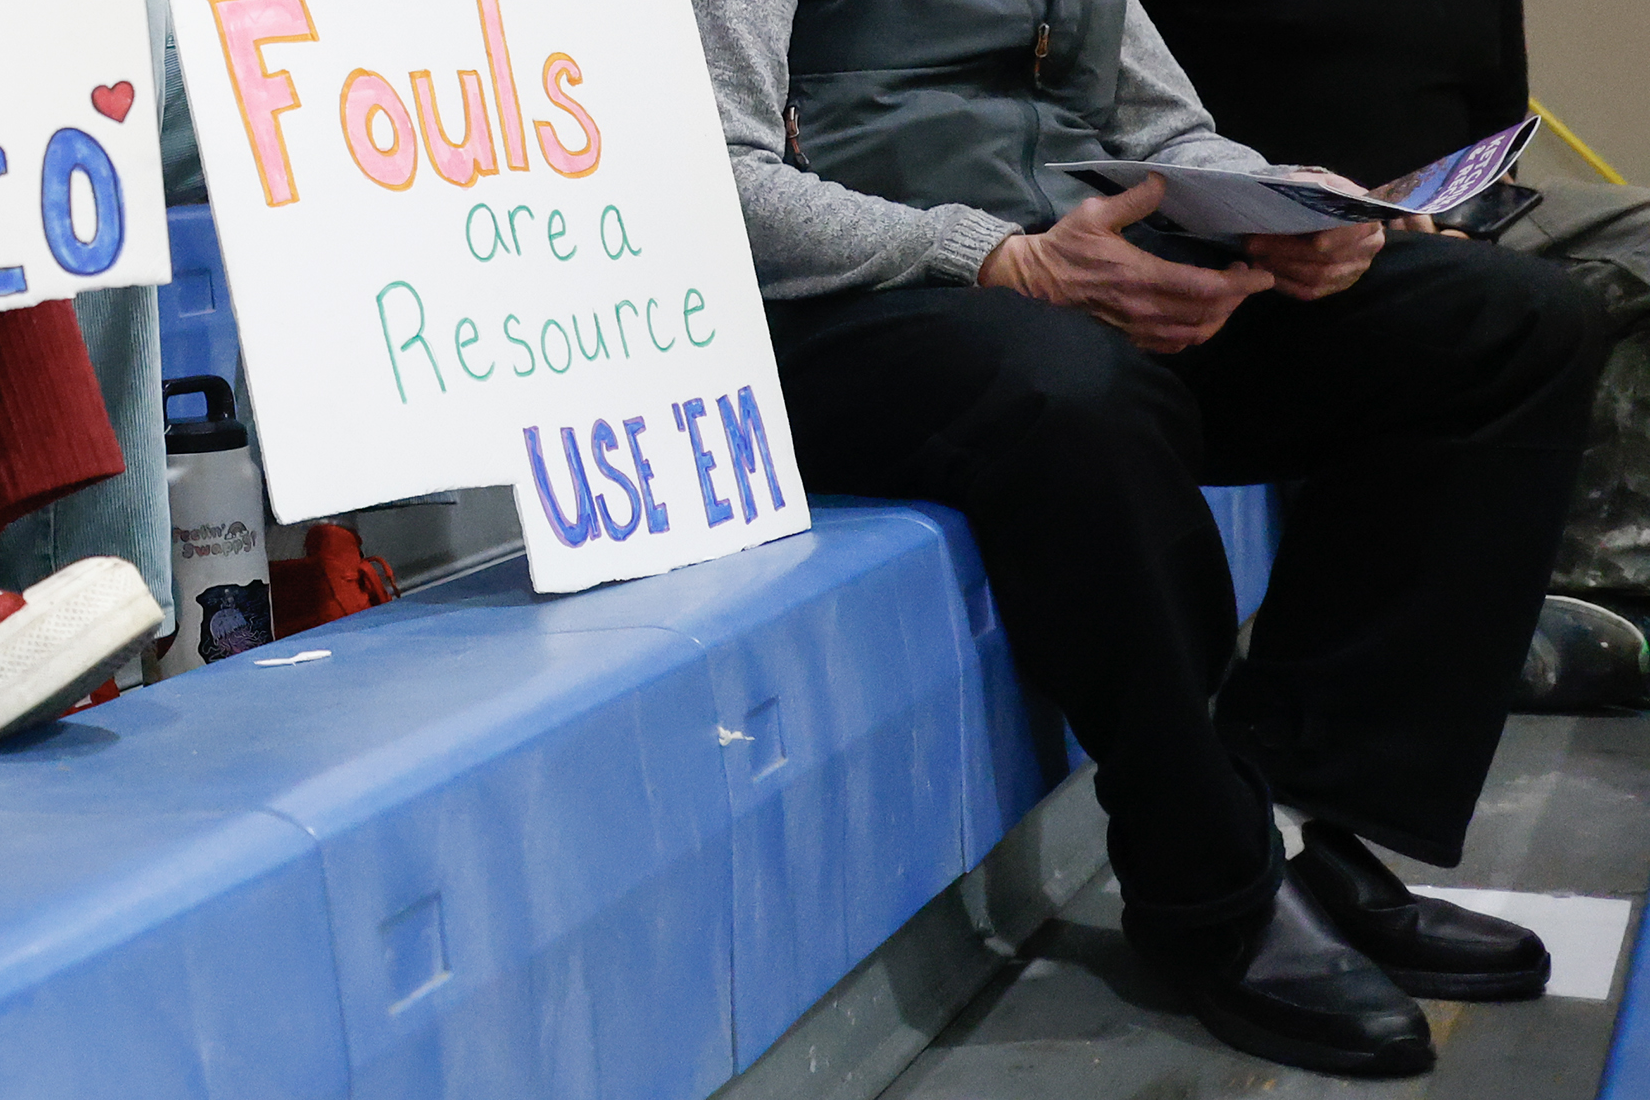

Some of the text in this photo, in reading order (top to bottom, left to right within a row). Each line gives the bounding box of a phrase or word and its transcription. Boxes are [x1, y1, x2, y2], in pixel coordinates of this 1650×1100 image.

[465, 202, 643, 263] are a
[375, 280, 718, 405] Resource
[522, 384, 787, 549] USE 'EM
